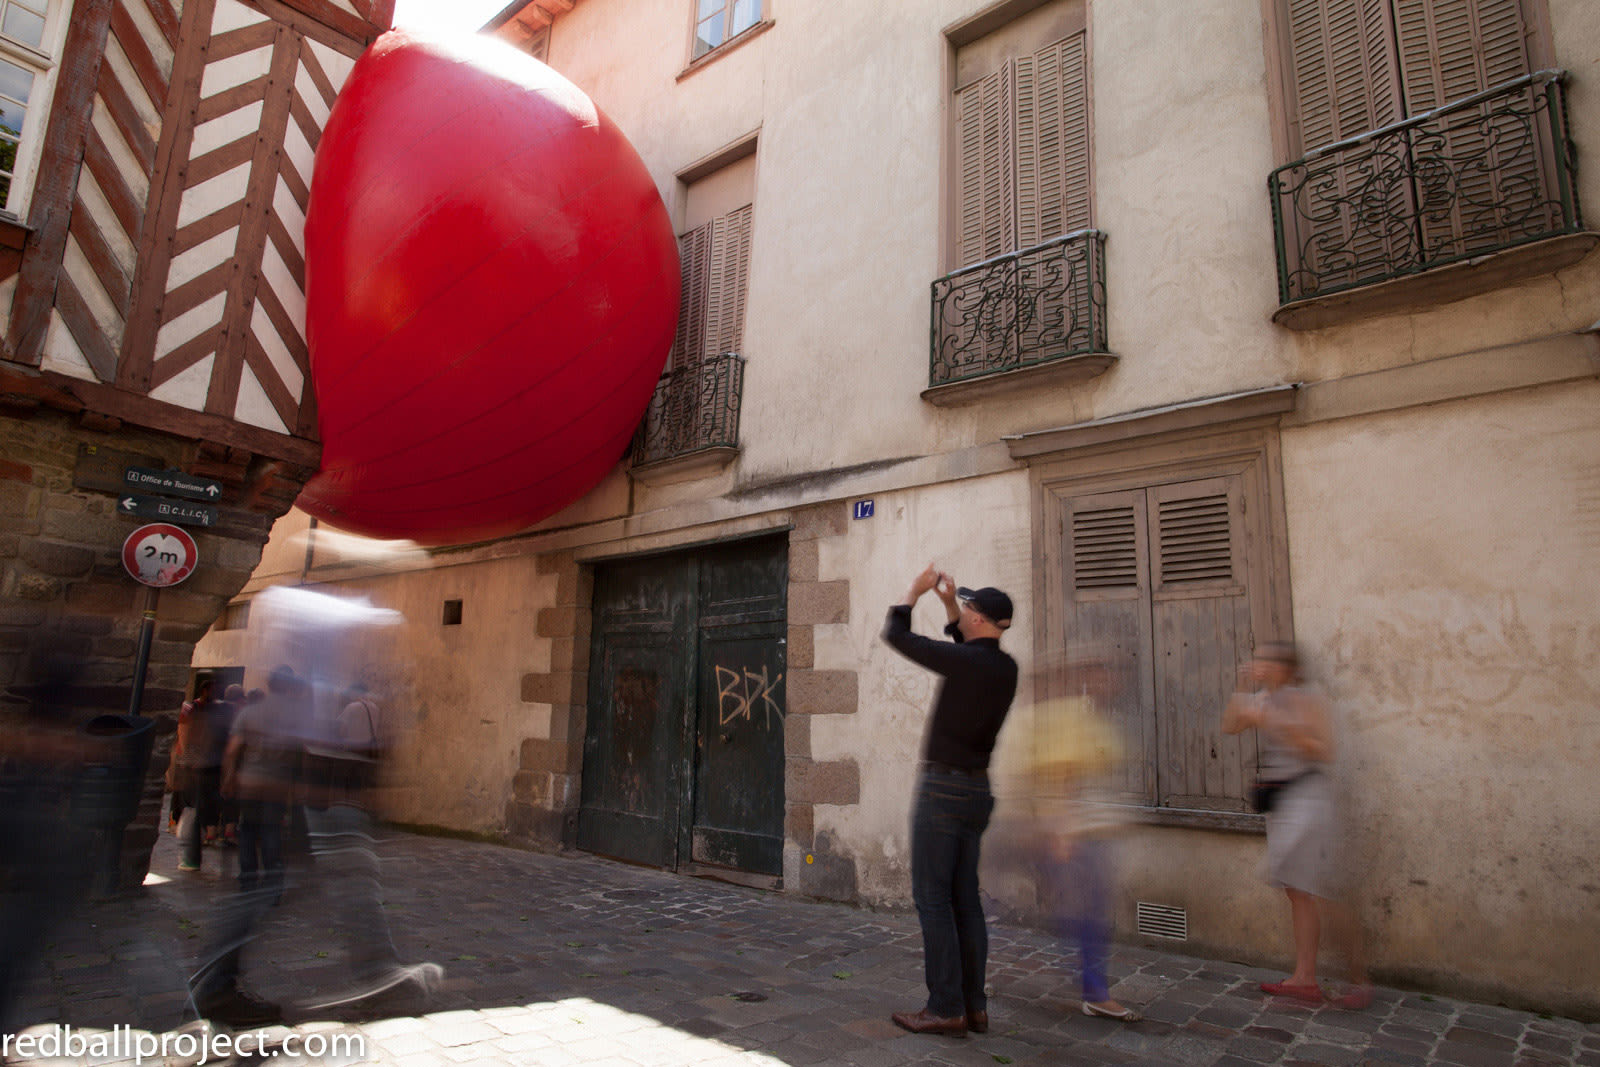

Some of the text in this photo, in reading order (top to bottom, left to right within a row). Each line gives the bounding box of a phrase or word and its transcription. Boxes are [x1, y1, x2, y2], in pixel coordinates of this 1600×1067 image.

[140, 474, 205, 493] Office de Tourisme
[857, 500, 873, 518] 17
